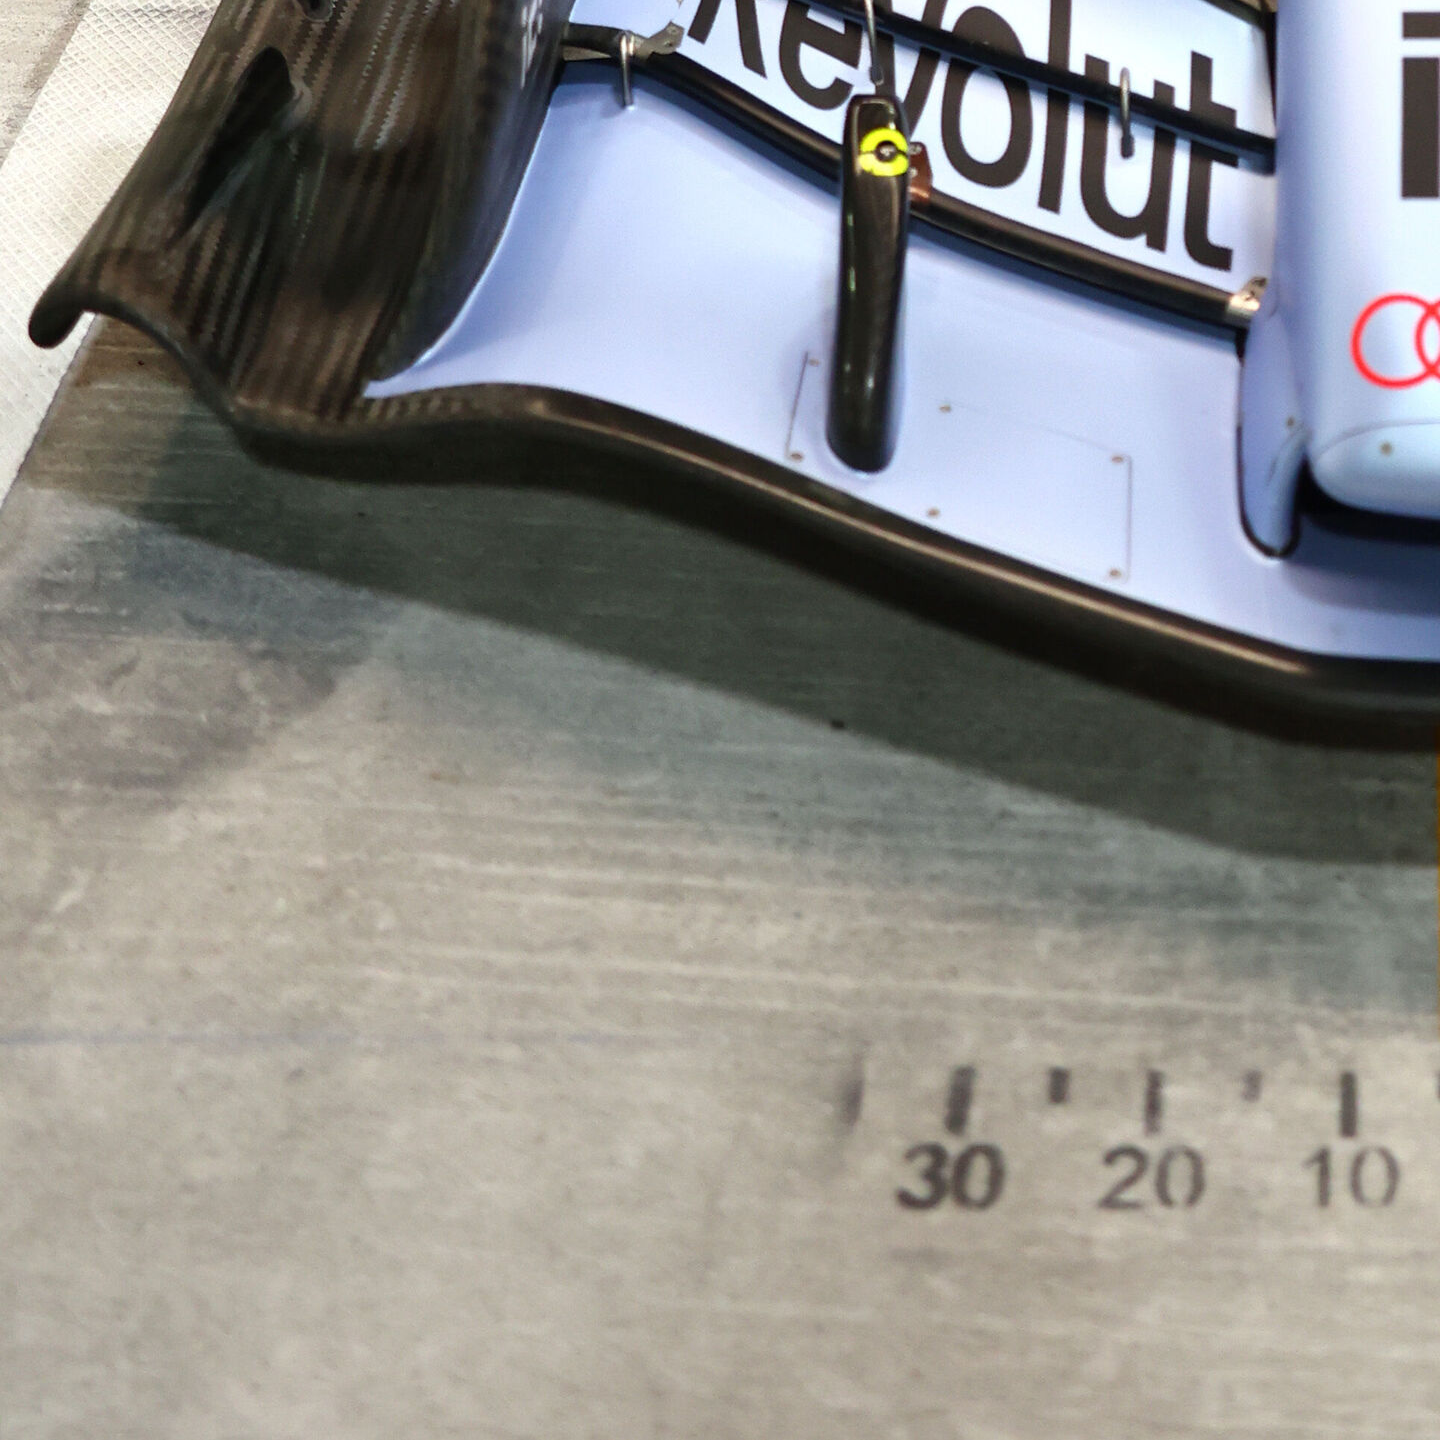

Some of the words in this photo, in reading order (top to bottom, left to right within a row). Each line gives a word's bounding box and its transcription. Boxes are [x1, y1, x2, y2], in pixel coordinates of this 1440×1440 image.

[898, 1142, 1003, 1211] 30
[1098, 1144, 1206, 1210] 20
[1303, 1143, 1400, 1209] 10
